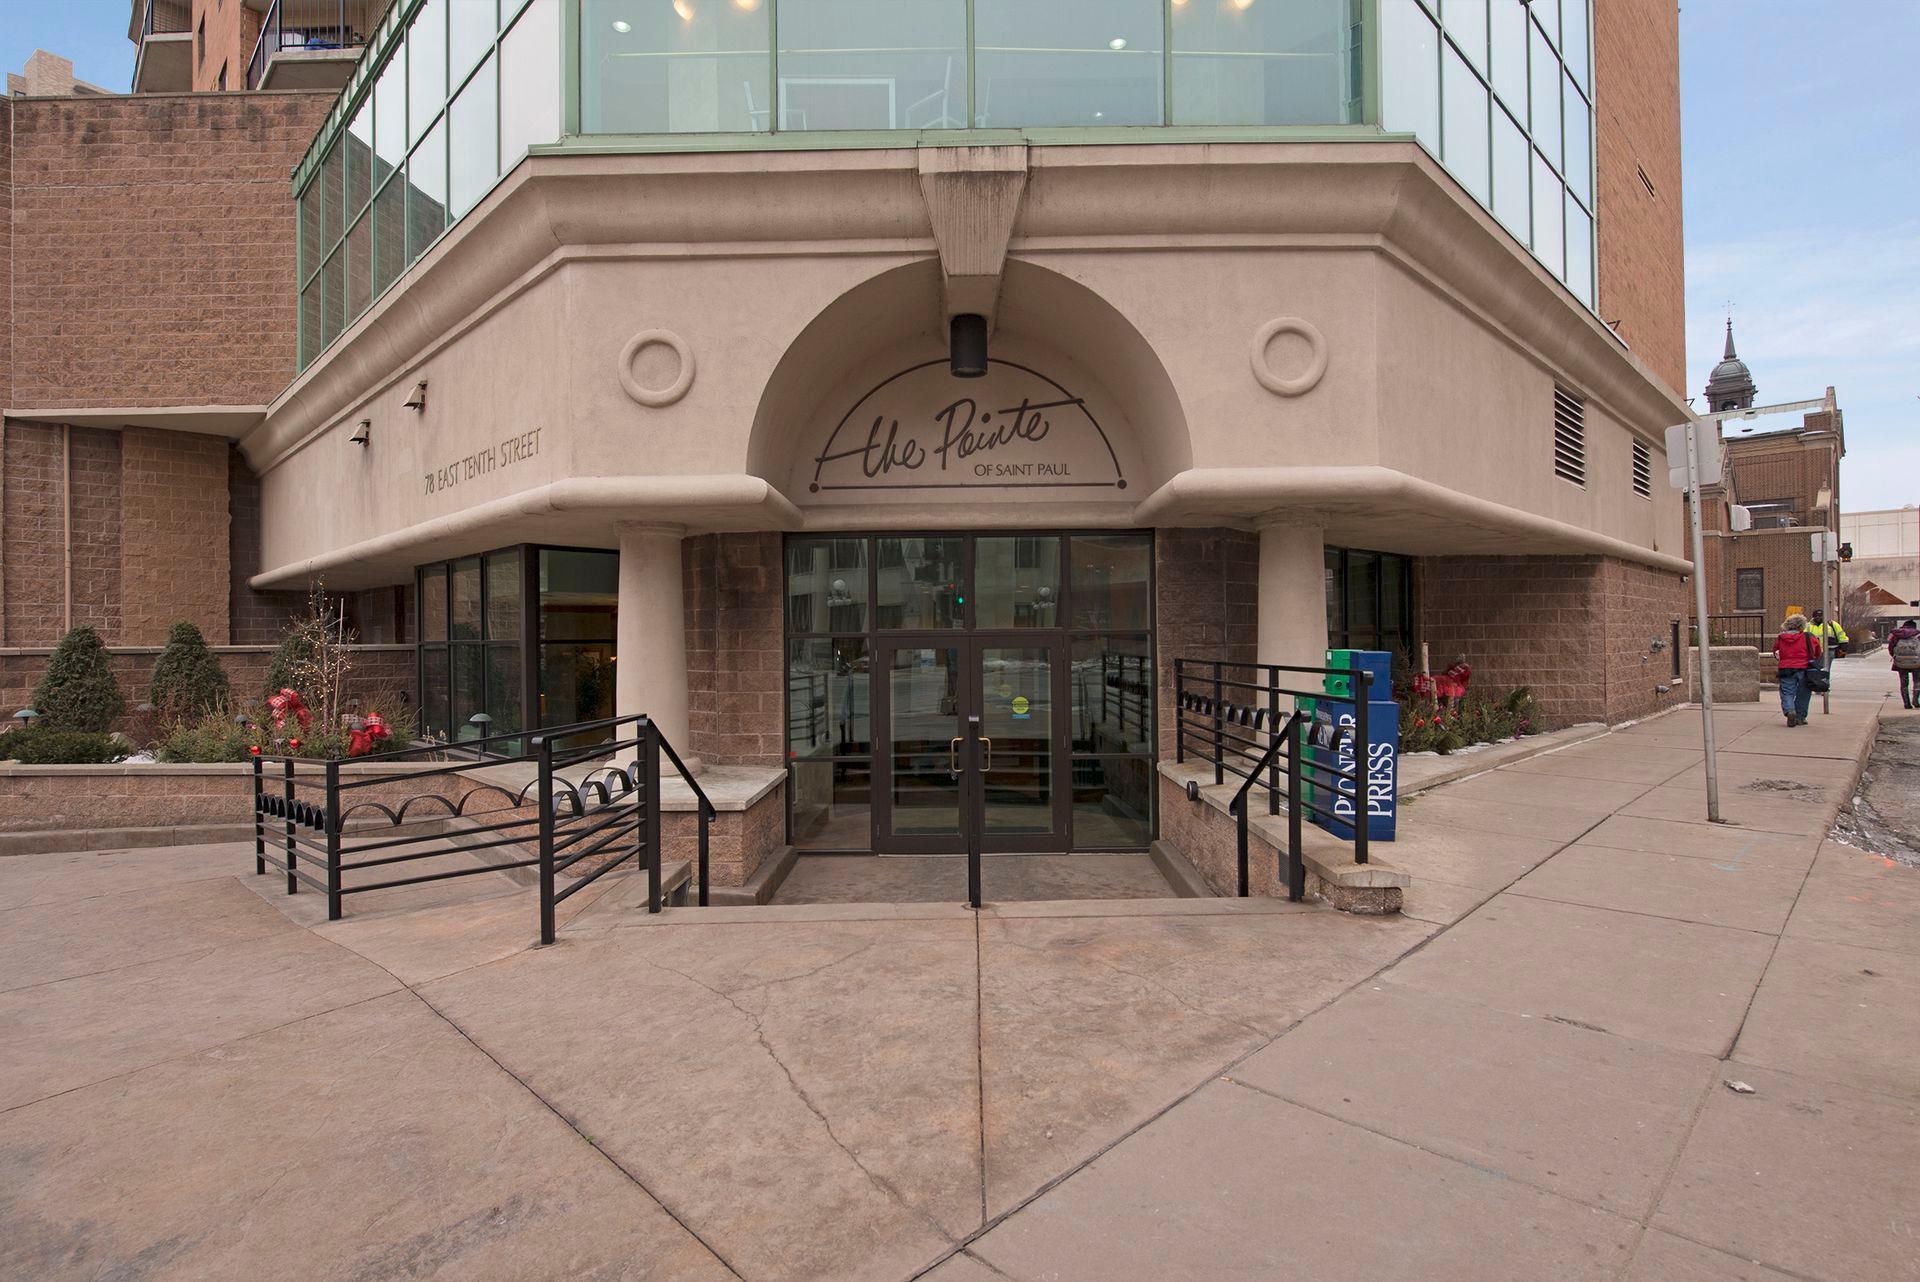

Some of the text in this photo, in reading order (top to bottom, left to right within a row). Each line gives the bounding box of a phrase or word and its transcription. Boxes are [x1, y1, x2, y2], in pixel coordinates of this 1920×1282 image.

[424, 427, 542, 495] 78 EAST TENTH STREET
[934, 398, 1085, 470] Pointe
[974, 463, 1071, 477] OF SAINT PAUL
[1366, 742, 1394, 818] PRESS
